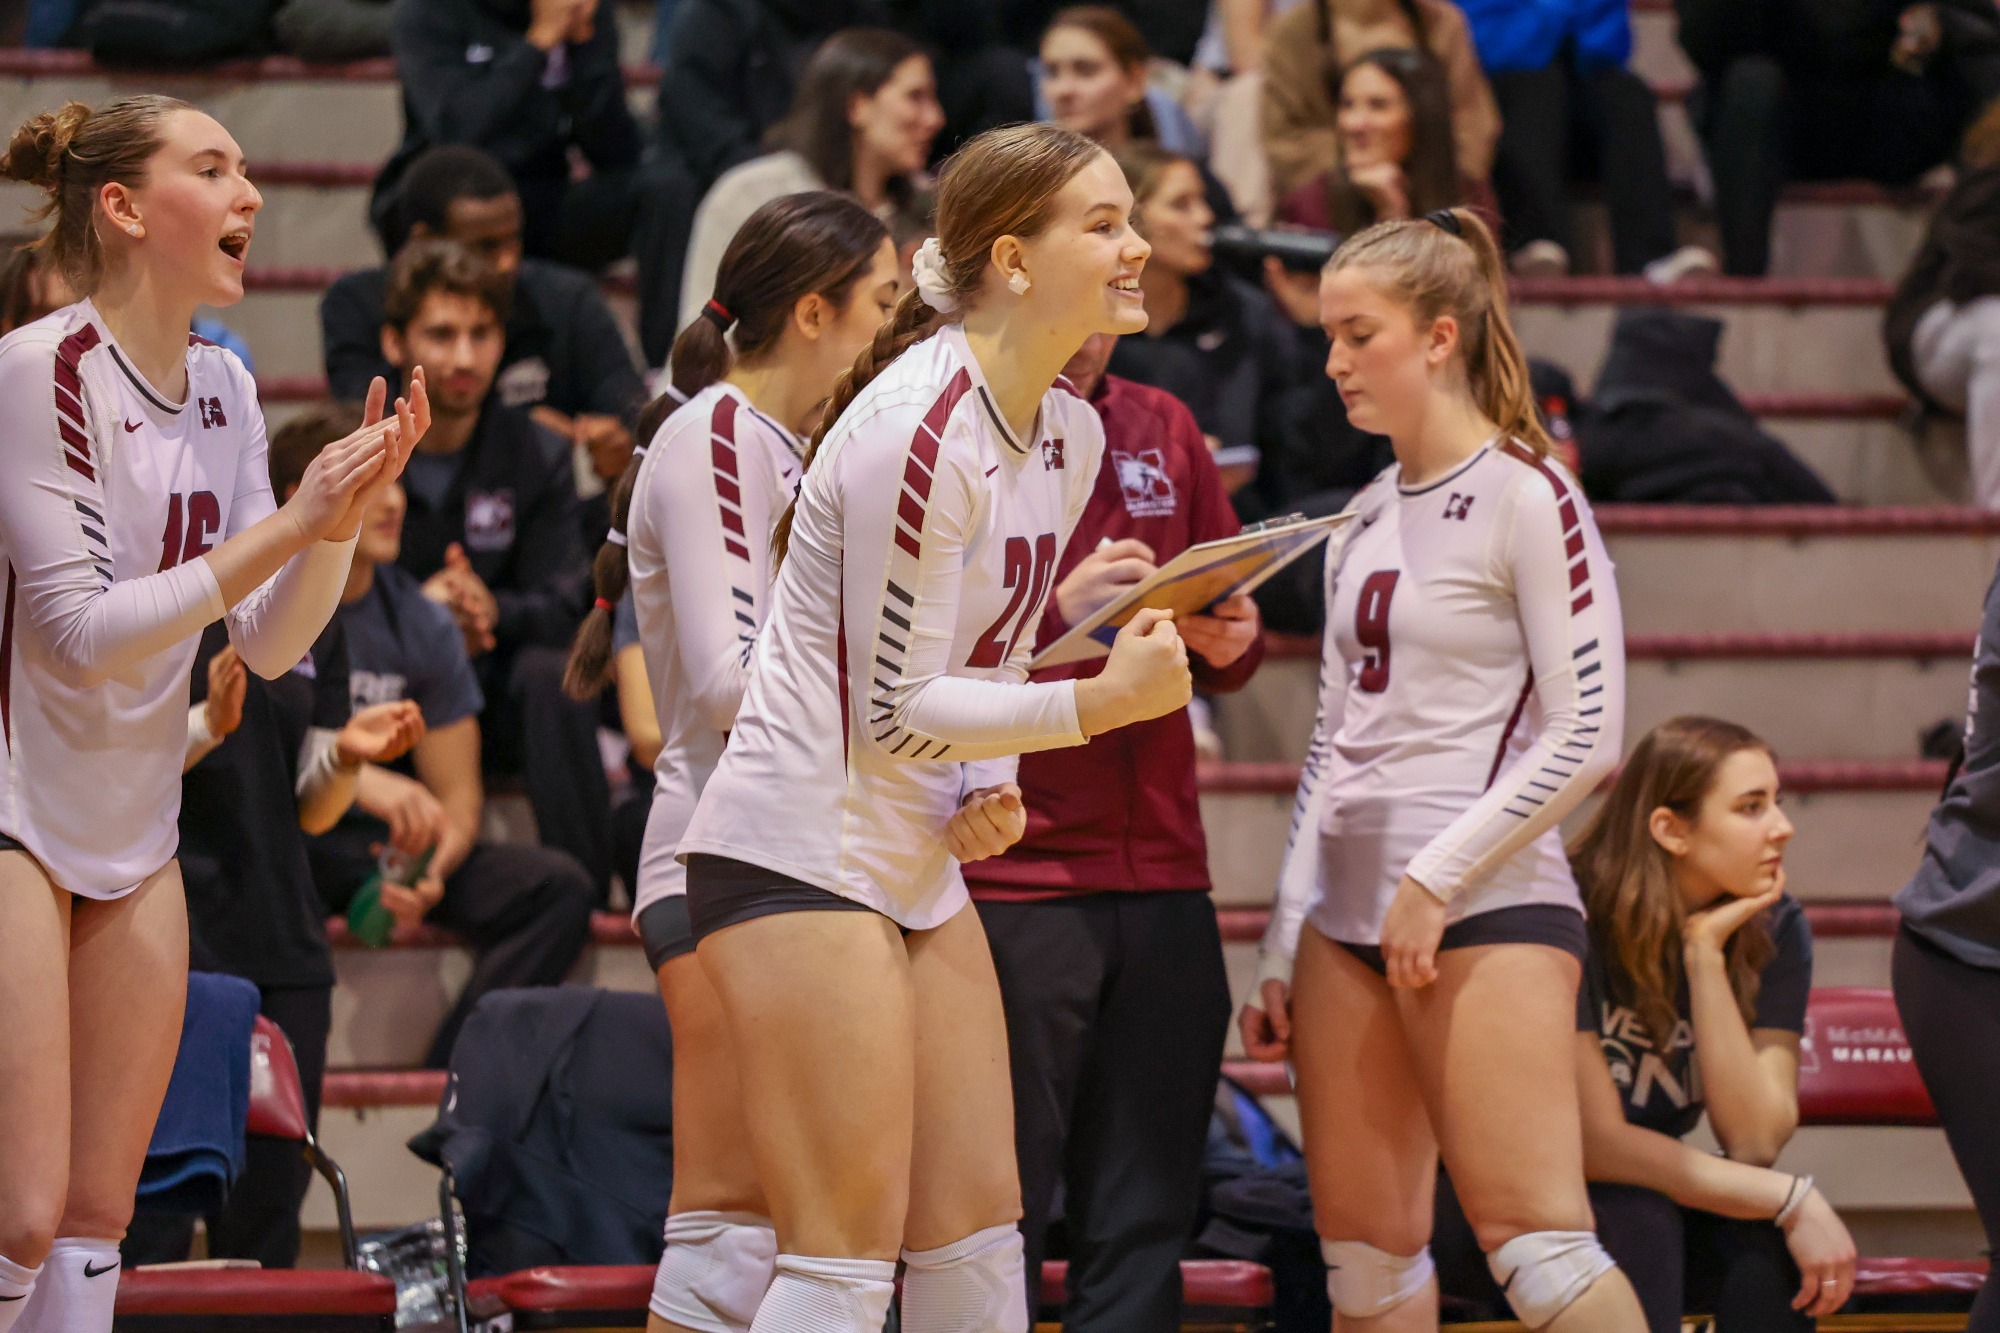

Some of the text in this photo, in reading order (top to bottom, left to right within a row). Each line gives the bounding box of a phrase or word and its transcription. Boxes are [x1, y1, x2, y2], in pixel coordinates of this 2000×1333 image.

[157, 490, 221, 574] 16
[965, 532, 1057, 668] 20
[1354, 568, 1401, 694] 9
